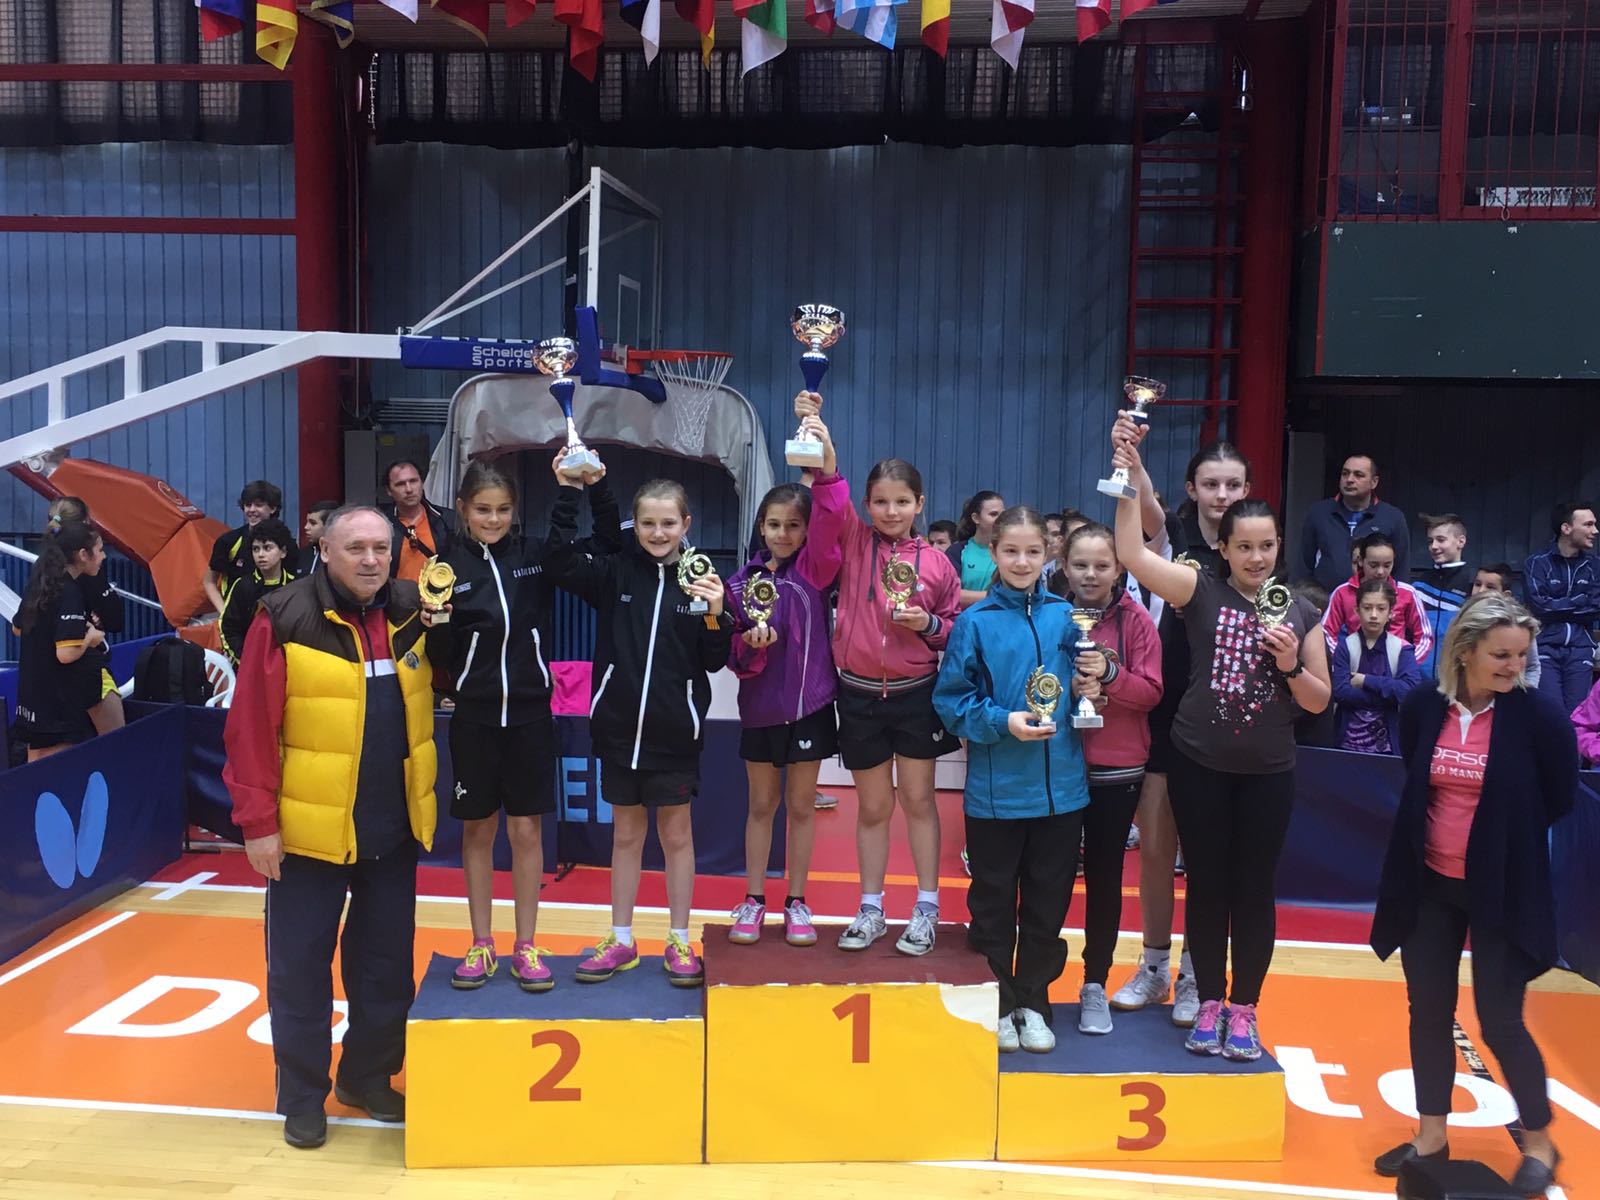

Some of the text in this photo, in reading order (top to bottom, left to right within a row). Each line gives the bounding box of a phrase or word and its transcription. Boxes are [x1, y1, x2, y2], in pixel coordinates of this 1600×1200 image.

[472, 346, 532, 358] Schelde
[472, 356, 533, 368] Sports
[832, 992, 871, 1064] 1
[529, 1029, 582, 1102] 2
[1116, 1081, 1167, 1152] 3
